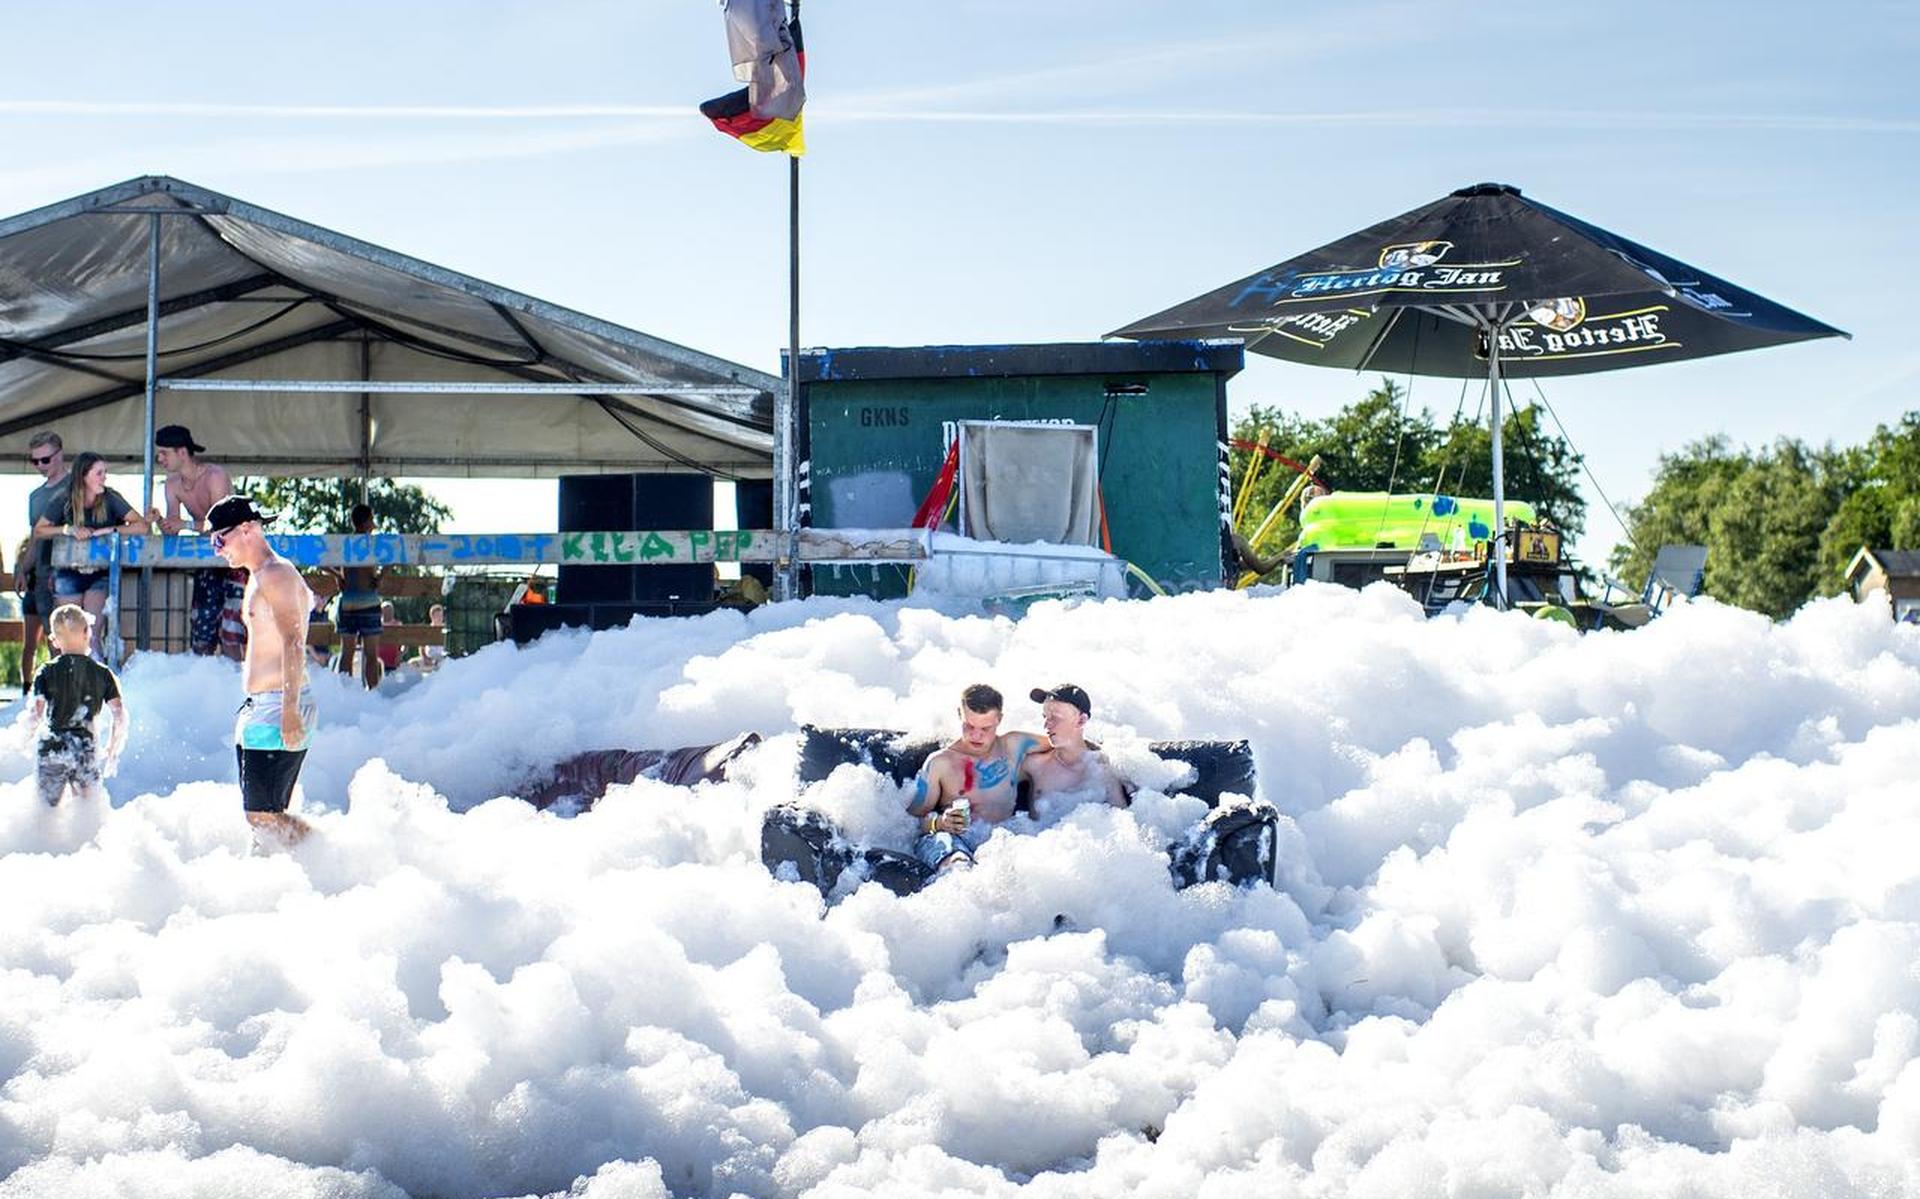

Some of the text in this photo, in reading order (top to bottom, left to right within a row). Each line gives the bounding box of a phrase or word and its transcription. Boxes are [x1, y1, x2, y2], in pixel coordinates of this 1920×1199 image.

[1292, 268, 1502, 297] Hertog Jan
[861, 407, 910, 427] GKNS
